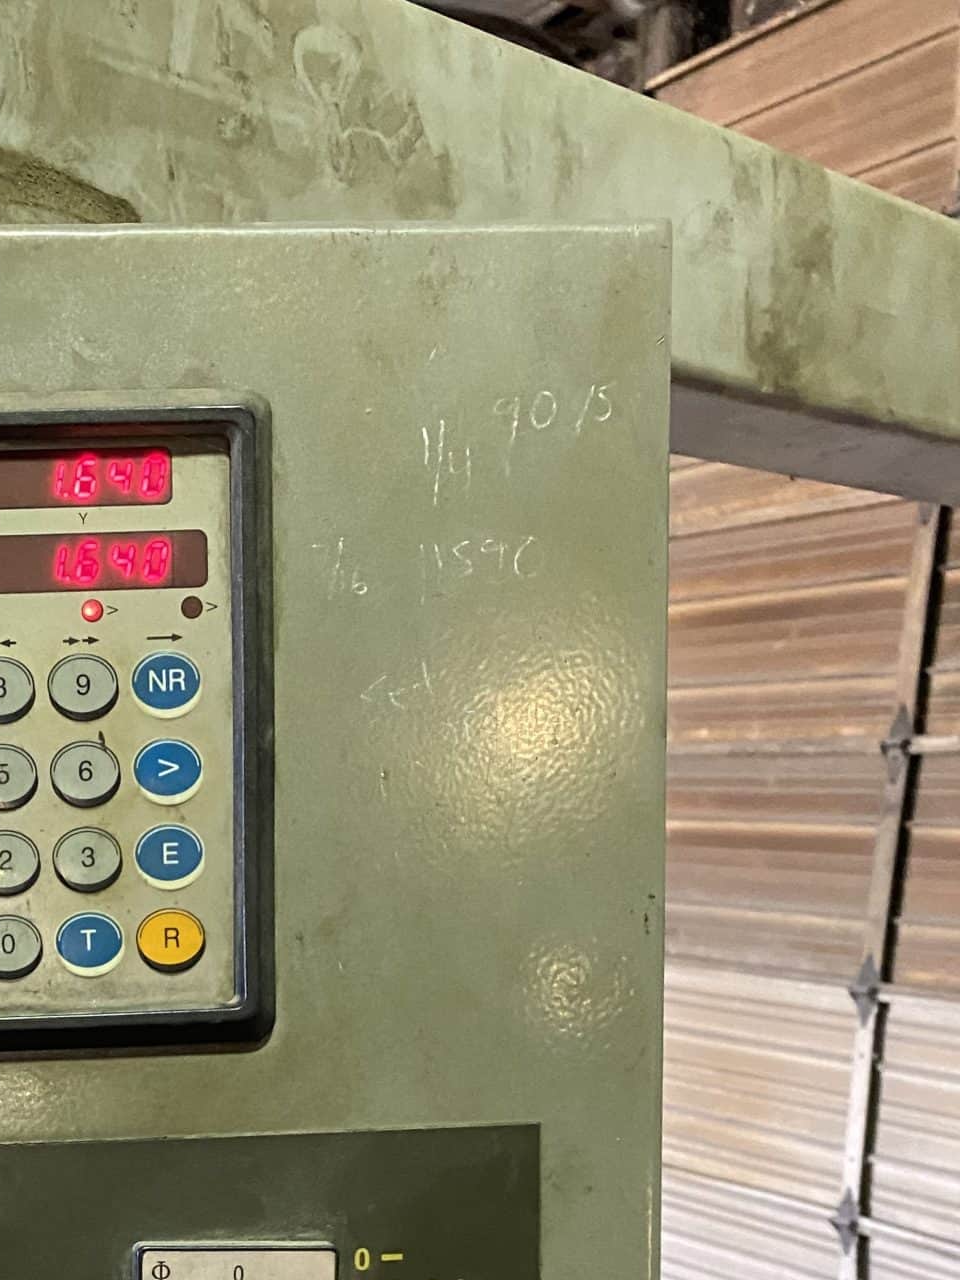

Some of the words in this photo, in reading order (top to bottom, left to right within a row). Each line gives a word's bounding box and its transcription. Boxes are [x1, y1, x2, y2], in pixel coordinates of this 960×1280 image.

[78, 512, 88, 525] Y
[75, 673, 91, 696] 9
[148, 667, 187, 693] NR
[78, 760, 94, 782] 6
[80, 846, 96, 868] 3
[162, 842, 179, 865] E
[80, 929, 98, 951] T
[164, 927, 181, 948] R
